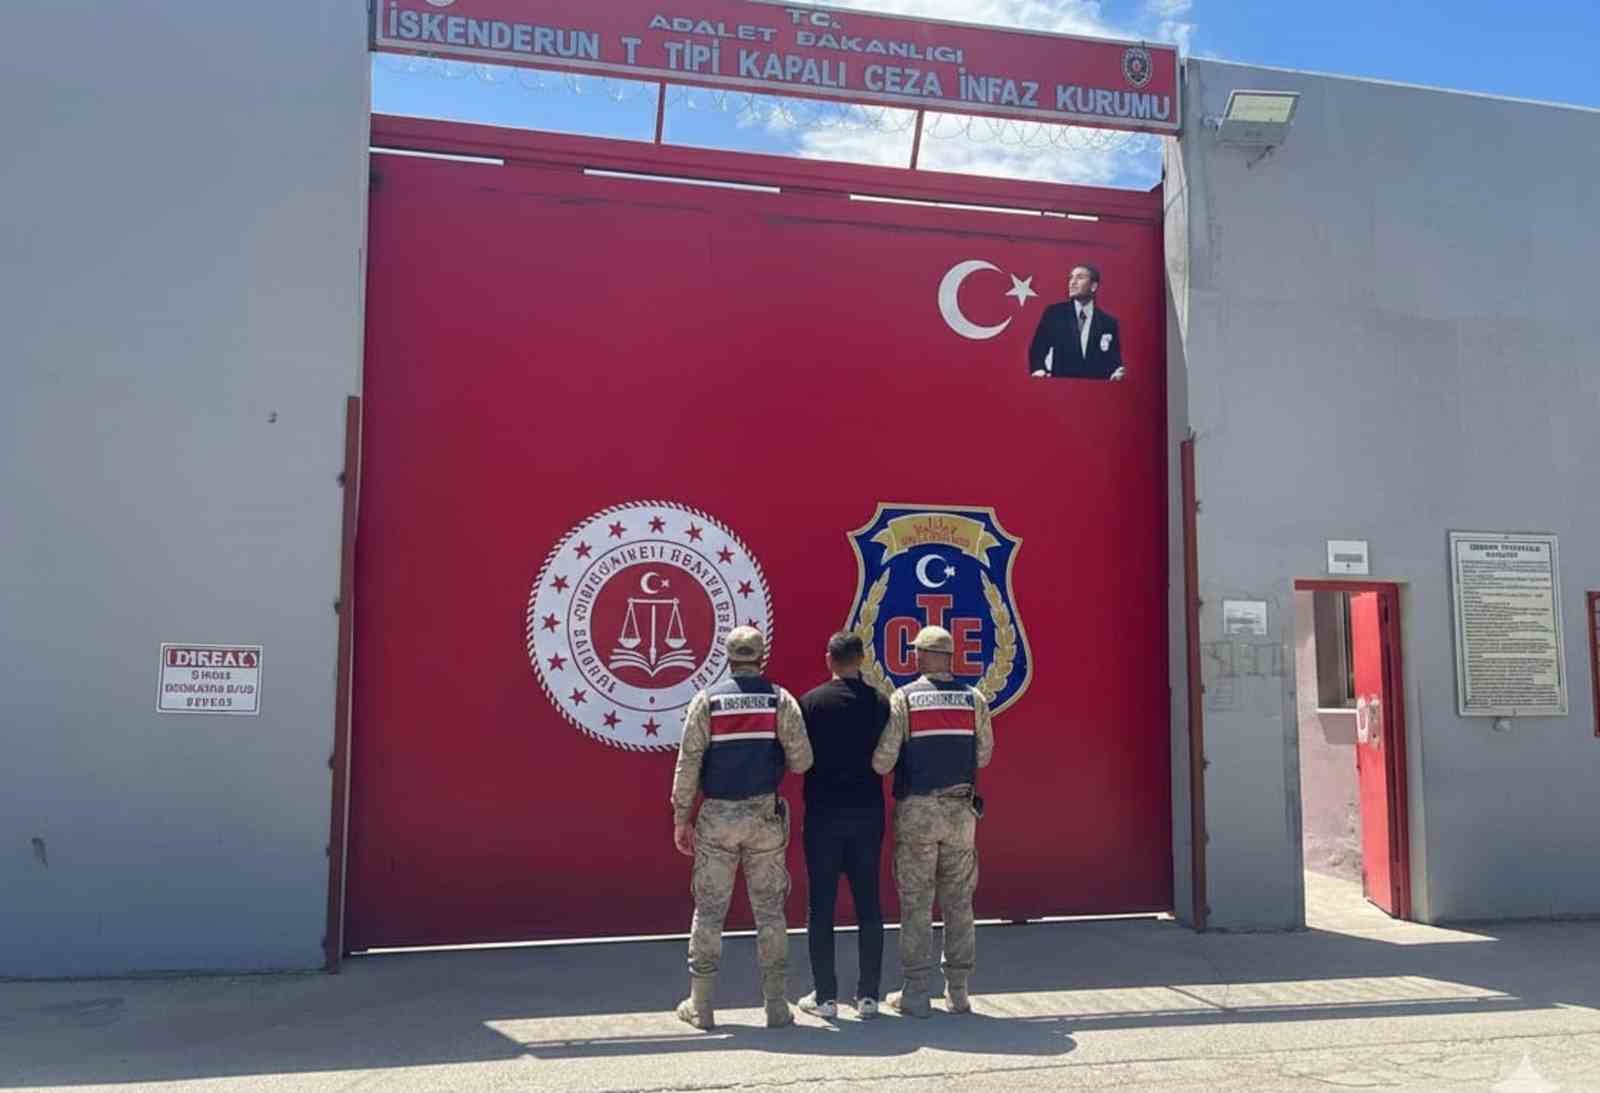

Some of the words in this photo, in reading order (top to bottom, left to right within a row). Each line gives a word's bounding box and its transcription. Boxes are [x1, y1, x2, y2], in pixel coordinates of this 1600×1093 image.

[389, 1, 600, 60] İSKENDERUN
[621, 35, 642, 65] T
[664, 39, 721, 74] TİPİ
[739, 48, 847, 88] KAPALI
[864, 63, 944, 97] CEZA
[958, 67, 1039, 108] İNFAZ
[1055, 84, 1170, 121] KURUMU
[648, 13, 778, 42] ADALET
